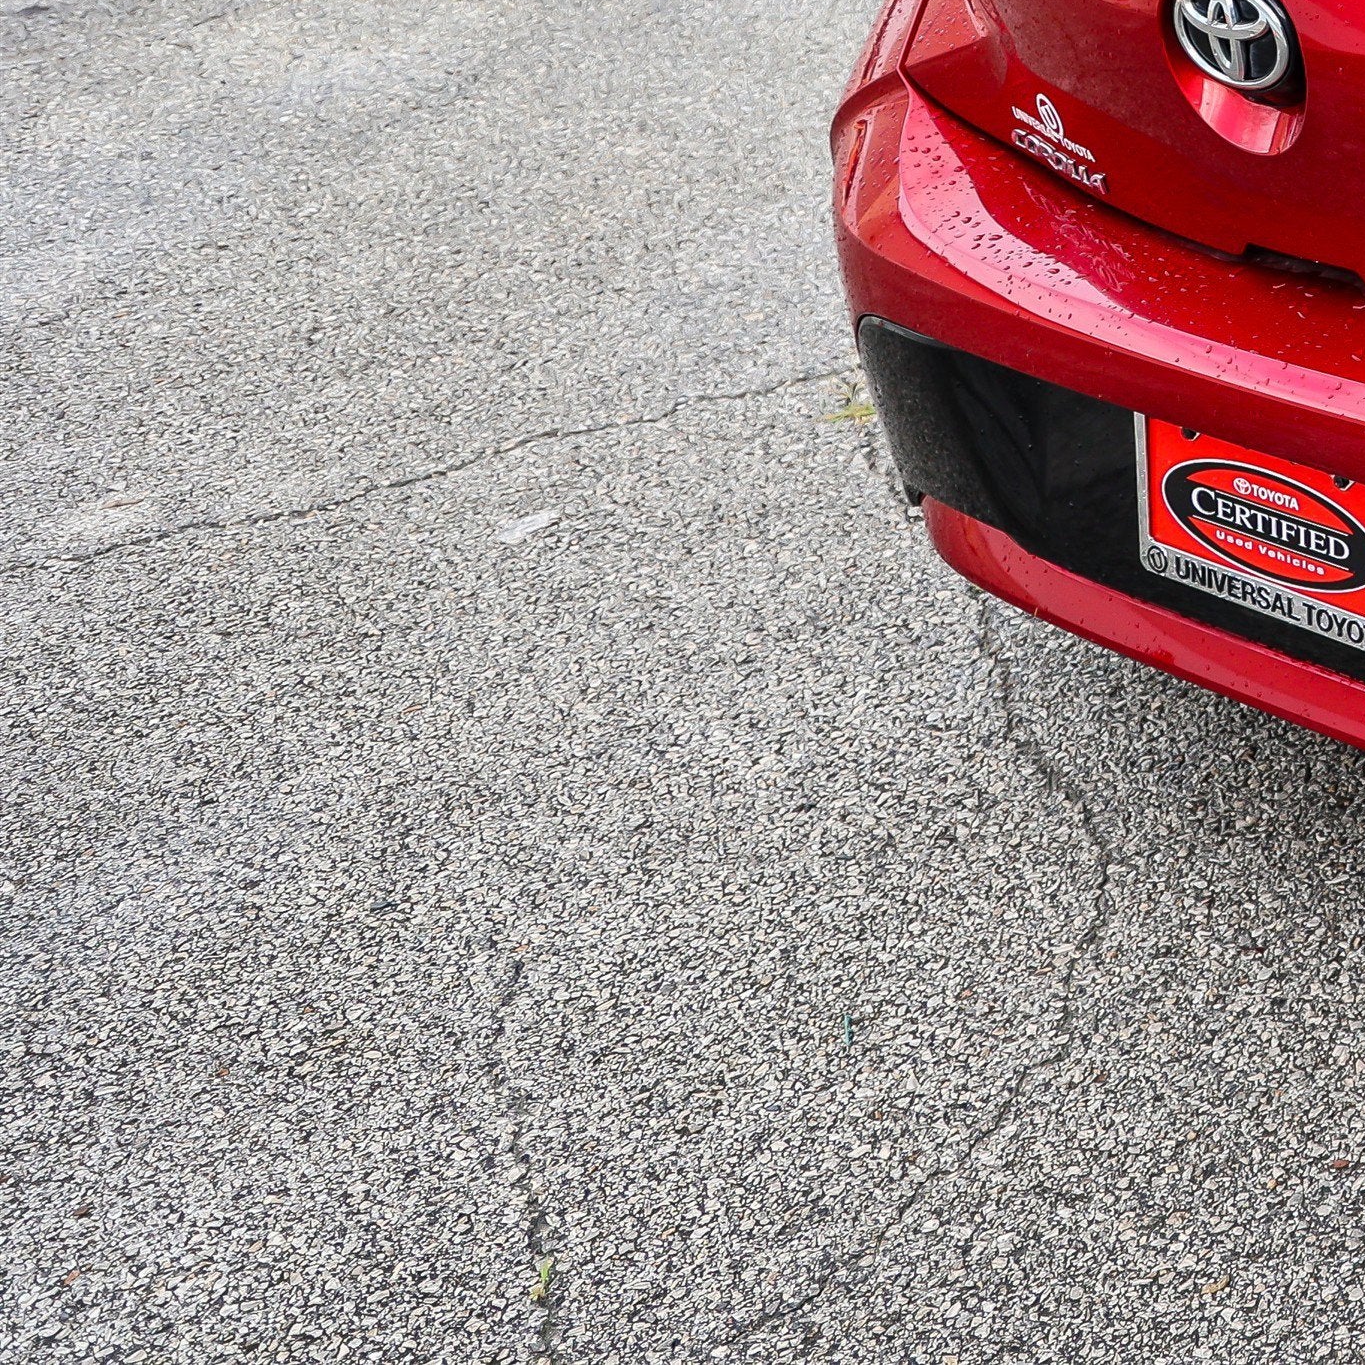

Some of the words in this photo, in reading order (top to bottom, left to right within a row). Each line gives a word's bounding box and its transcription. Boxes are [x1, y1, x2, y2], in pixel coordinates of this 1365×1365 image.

[1011, 128, 1106, 195] COROLLA
[1060, 136, 1096, 163] TOYOTA
[1191, 486, 1350, 560] CERTIFIED
[1251, 483, 1299, 511] TOYOTA
[1215, 530, 1253, 551] Used
[1258, 544, 1325, 575] Vehicles
[1175, 555, 1301, 621] UNIVERSAL
